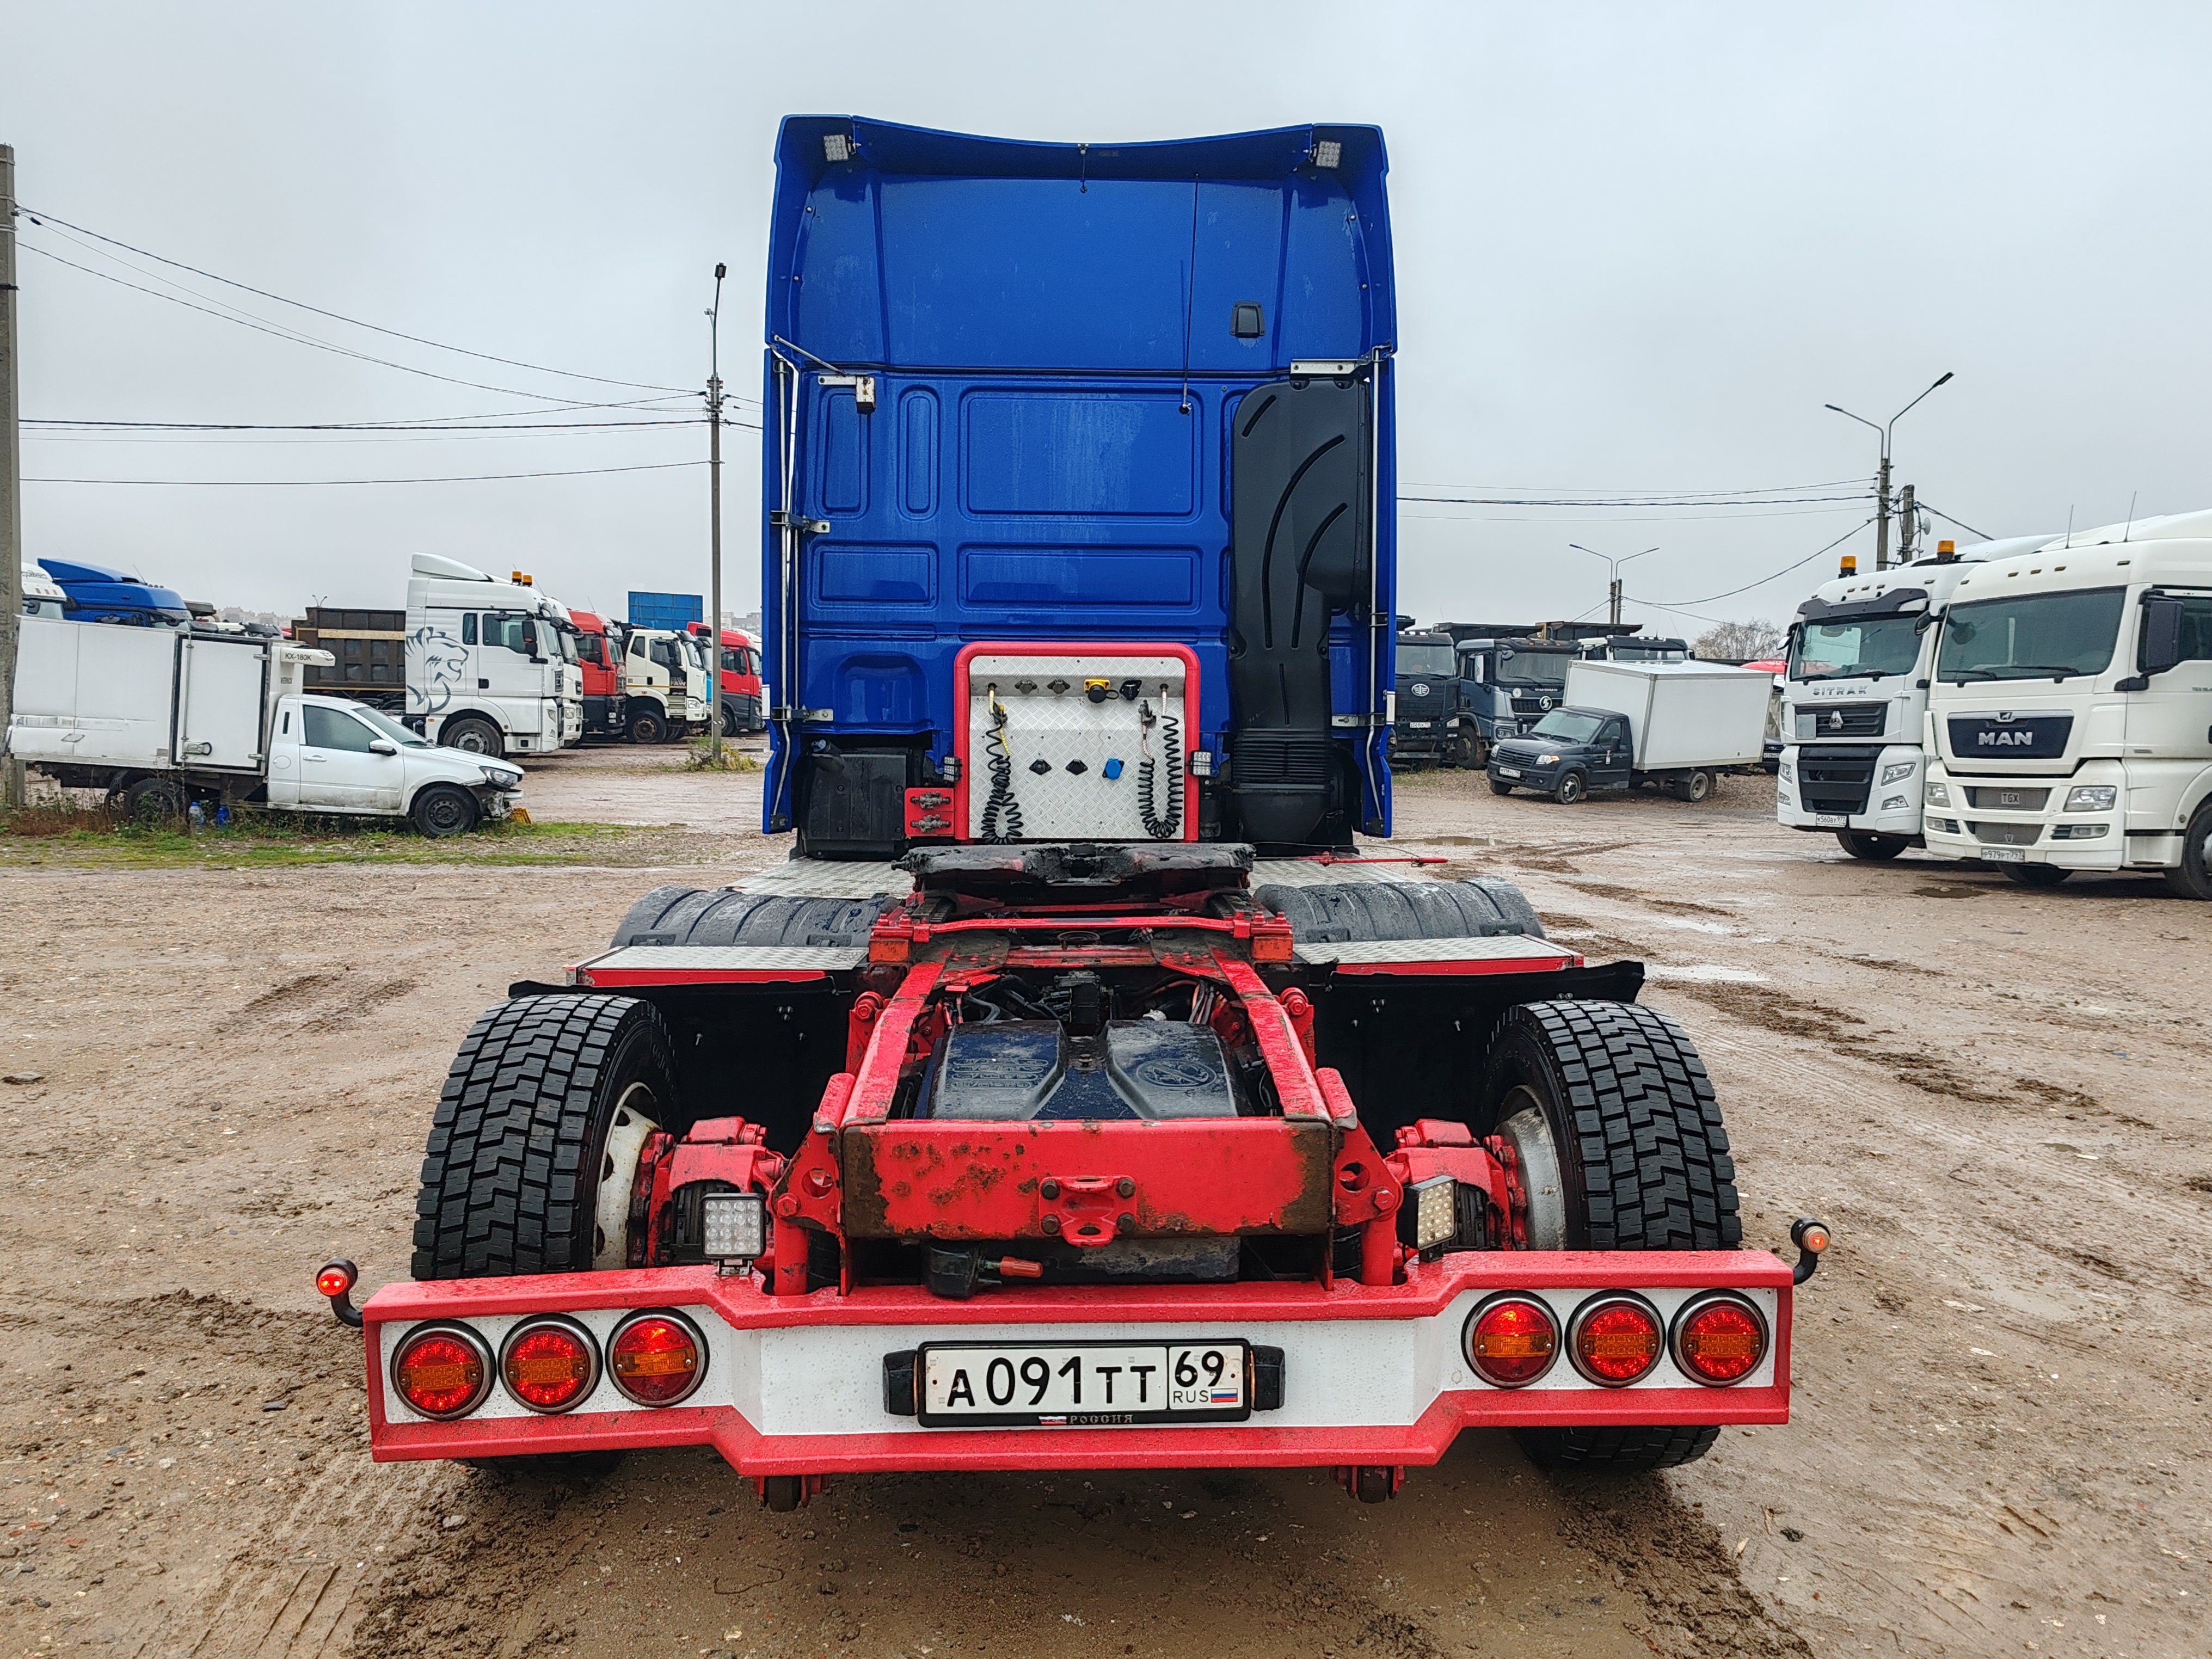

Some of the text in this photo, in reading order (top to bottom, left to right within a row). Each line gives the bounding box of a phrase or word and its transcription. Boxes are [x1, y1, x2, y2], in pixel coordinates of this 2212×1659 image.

[285, 653, 312, 661] KX-180K
[1813, 685, 1868, 696] SITRAK
[1978, 732, 2033, 745] MAN
[2002, 794, 2019, 803] TGX
[947, 1350, 1224, 1407] А091ТТ 69
[1173, 1390, 1209, 1404] RUS
[1069, 1414, 1133, 1424] РОССИЯ
